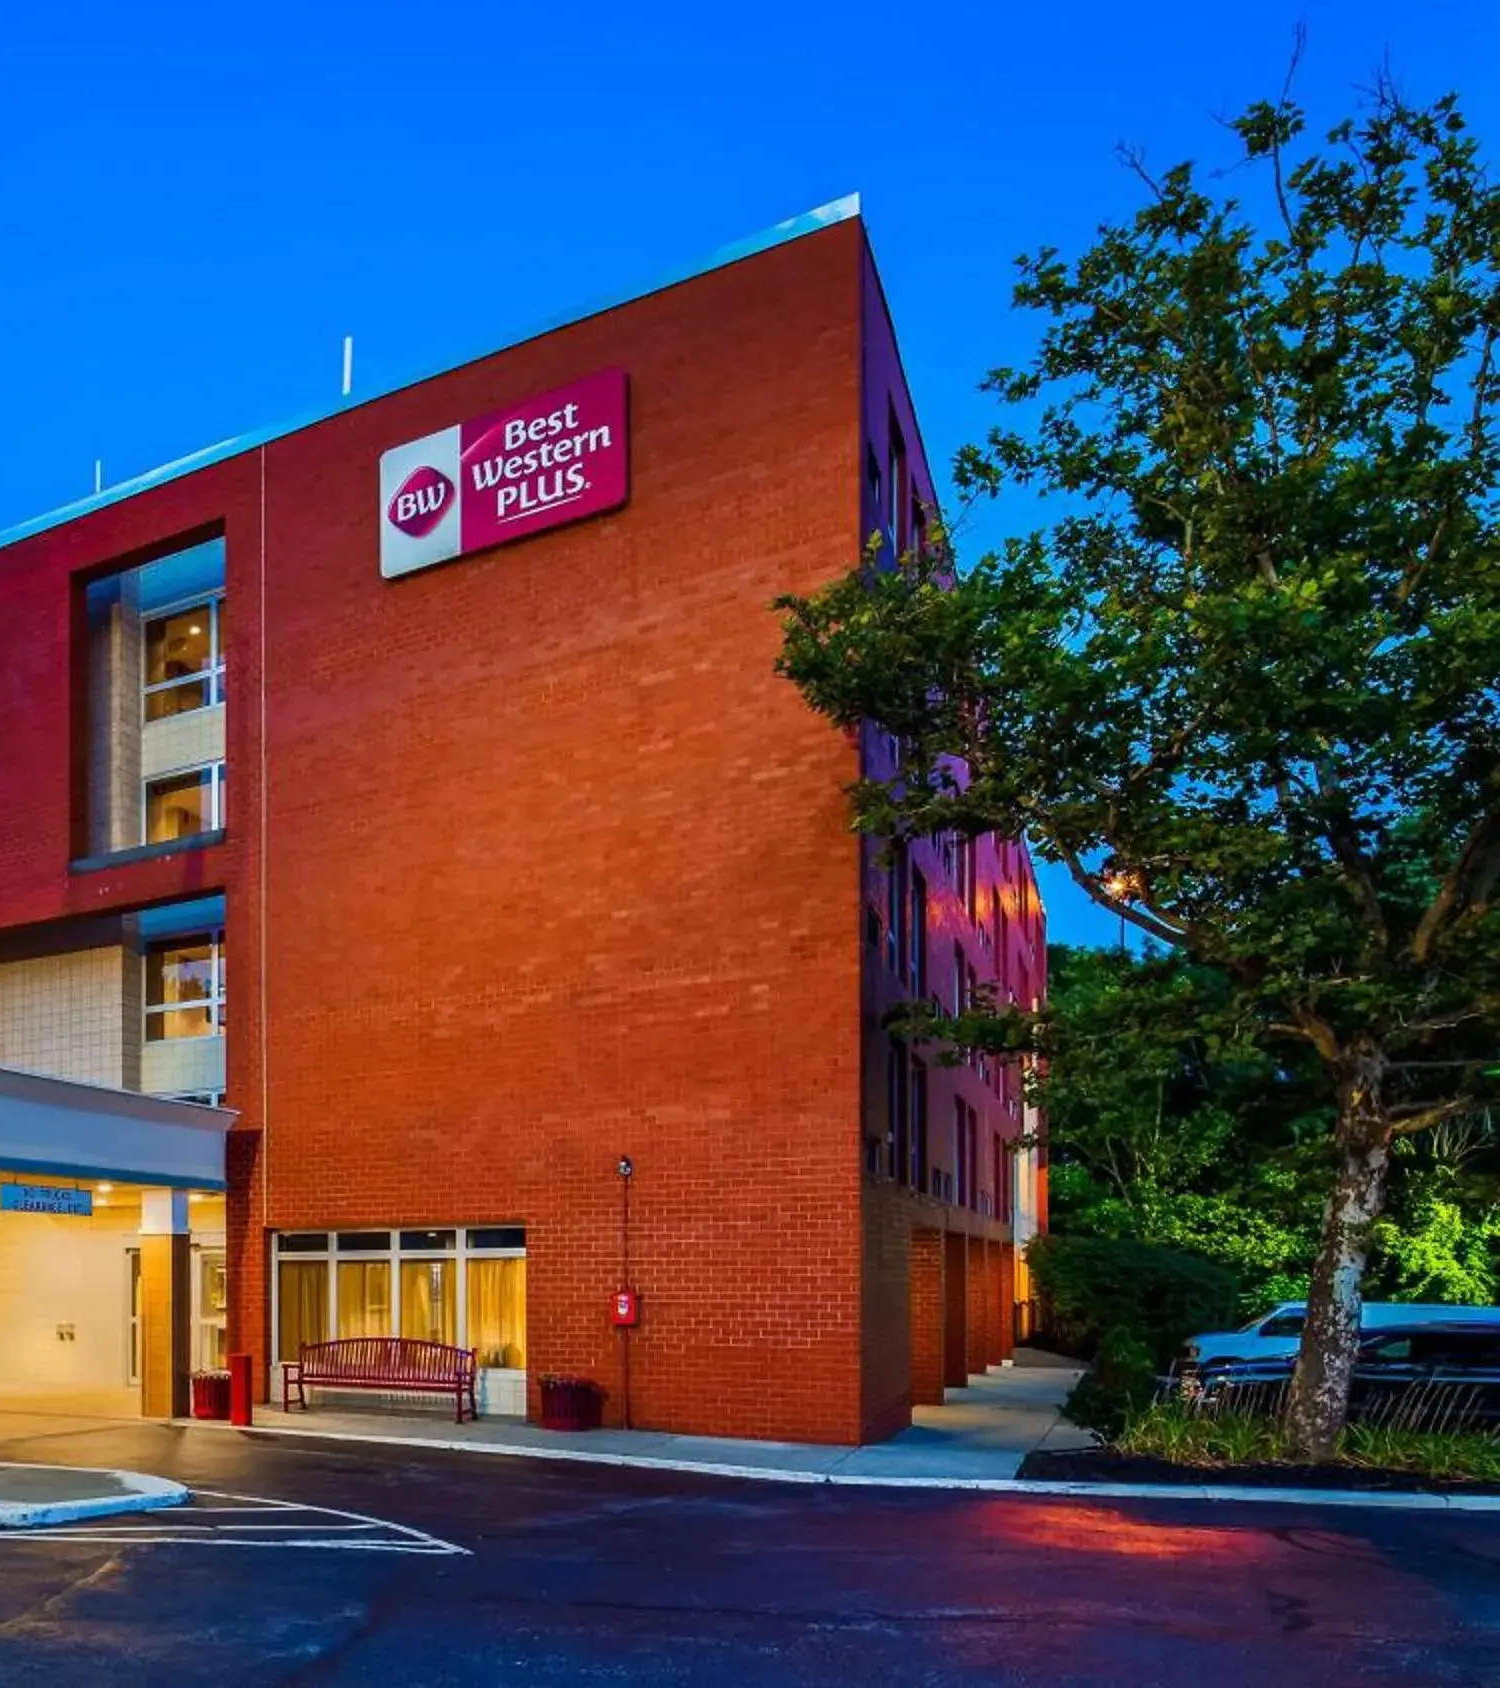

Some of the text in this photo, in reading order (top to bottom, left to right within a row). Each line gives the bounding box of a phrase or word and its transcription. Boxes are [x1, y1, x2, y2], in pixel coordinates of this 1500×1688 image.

[504, 402, 579, 451] Best
[472, 425, 612, 492] Western
[396, 483, 446, 521] BW
